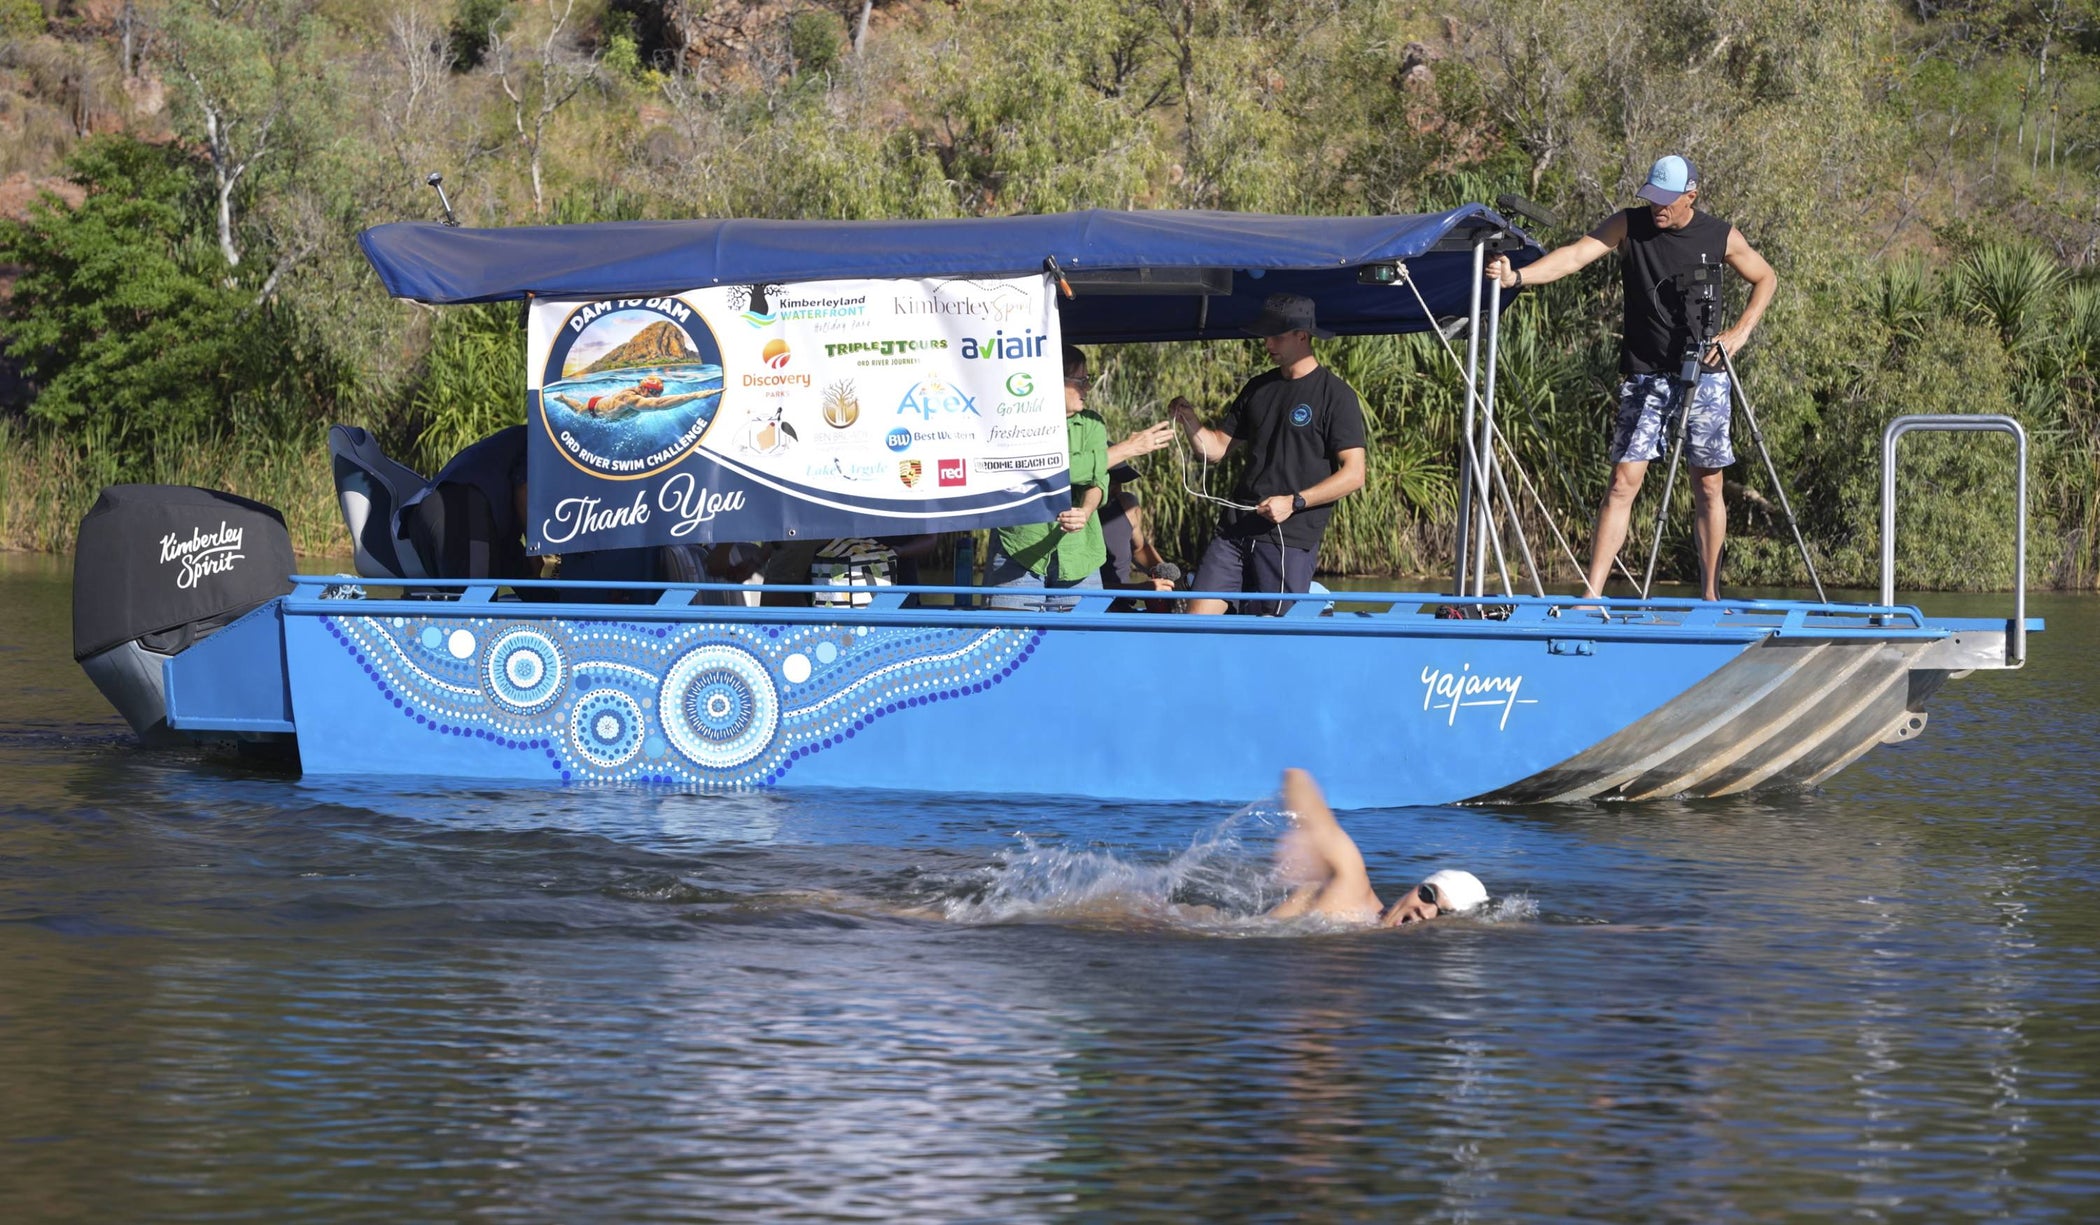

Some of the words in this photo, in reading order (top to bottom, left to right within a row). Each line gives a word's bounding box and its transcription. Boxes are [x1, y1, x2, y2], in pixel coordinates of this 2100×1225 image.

[569, 300, 612, 332] DAM
[645, 298, 690, 323] DAM
[780, 296, 866, 309] Kimberleyland
[780, 306, 865, 321] WATERFRONT
[895, 296, 990, 321] Kimberley
[962, 328, 1047, 360] aviair
[743, 374, 811, 388] Discovery
[896, 381, 983, 420] Apex
[560, 430, 580, 453] ORD
[579, 449, 609, 470] RIVER
[611, 458, 645, 471] SWIM
[646, 417, 708, 467] CHALLENGE
[888, 434, 910, 446] BW
[914, 432, 935, 440] Best
[937, 431, 975, 440] Wetern
[986, 424, 1060, 443] freshwater
[940, 458, 964, 480] red
[976, 460, 1013, 470] ROOME
[1014, 458, 1046, 468] BEACH
[1047, 456, 1060, 465] CO
[543, 490, 650, 543] Thank
[658, 472, 745, 537] You
[159, 521, 243, 564] Kimberley
[176, 552, 245, 589] Spirit
